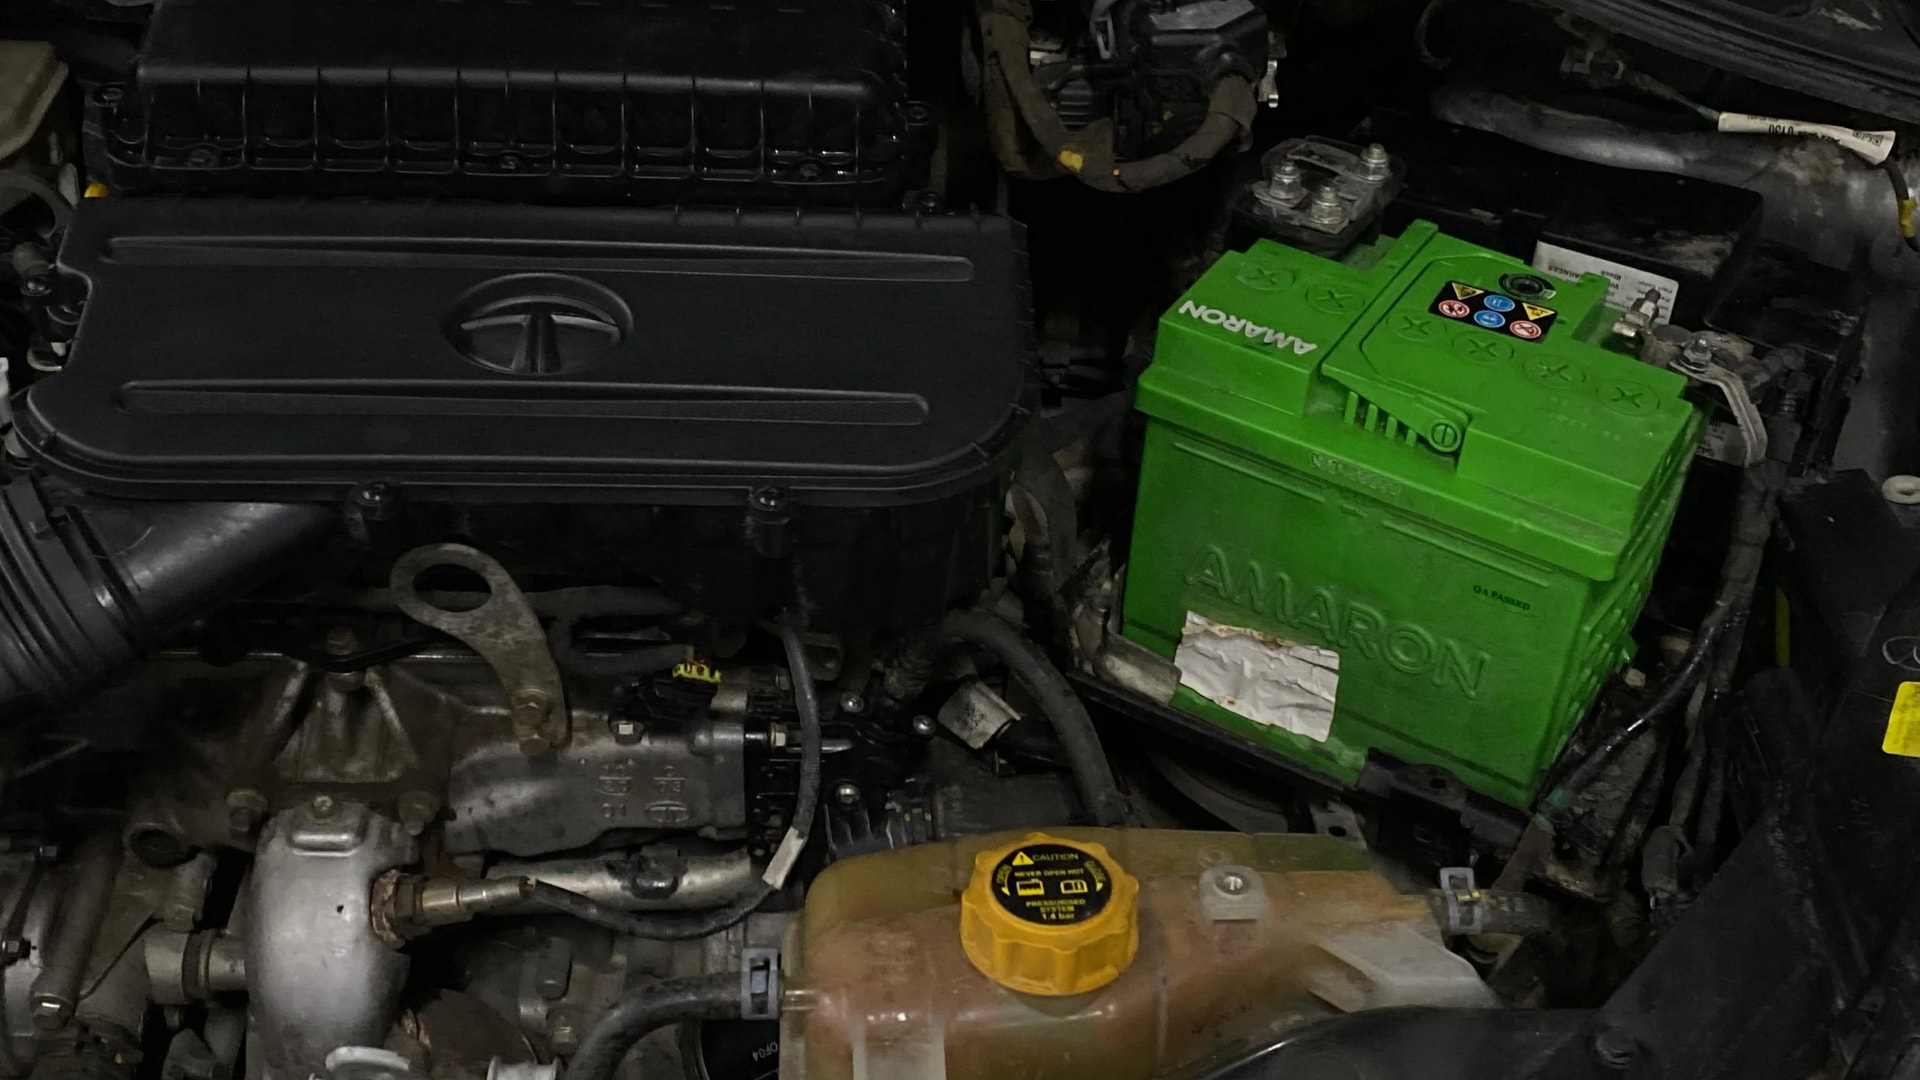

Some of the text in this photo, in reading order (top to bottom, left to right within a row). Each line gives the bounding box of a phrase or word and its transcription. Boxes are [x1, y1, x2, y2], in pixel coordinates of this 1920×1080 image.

[1178, 300, 1318, 356] AMARON
[1473, 585, 1530, 610] QA PASSED
[1184, 543, 1492, 700] AMARON
[1032, 853, 1079, 861] CAUTION
[1014, 869, 1042, 877] NEVER
[1039, 905, 1075, 913] SYSTEM
